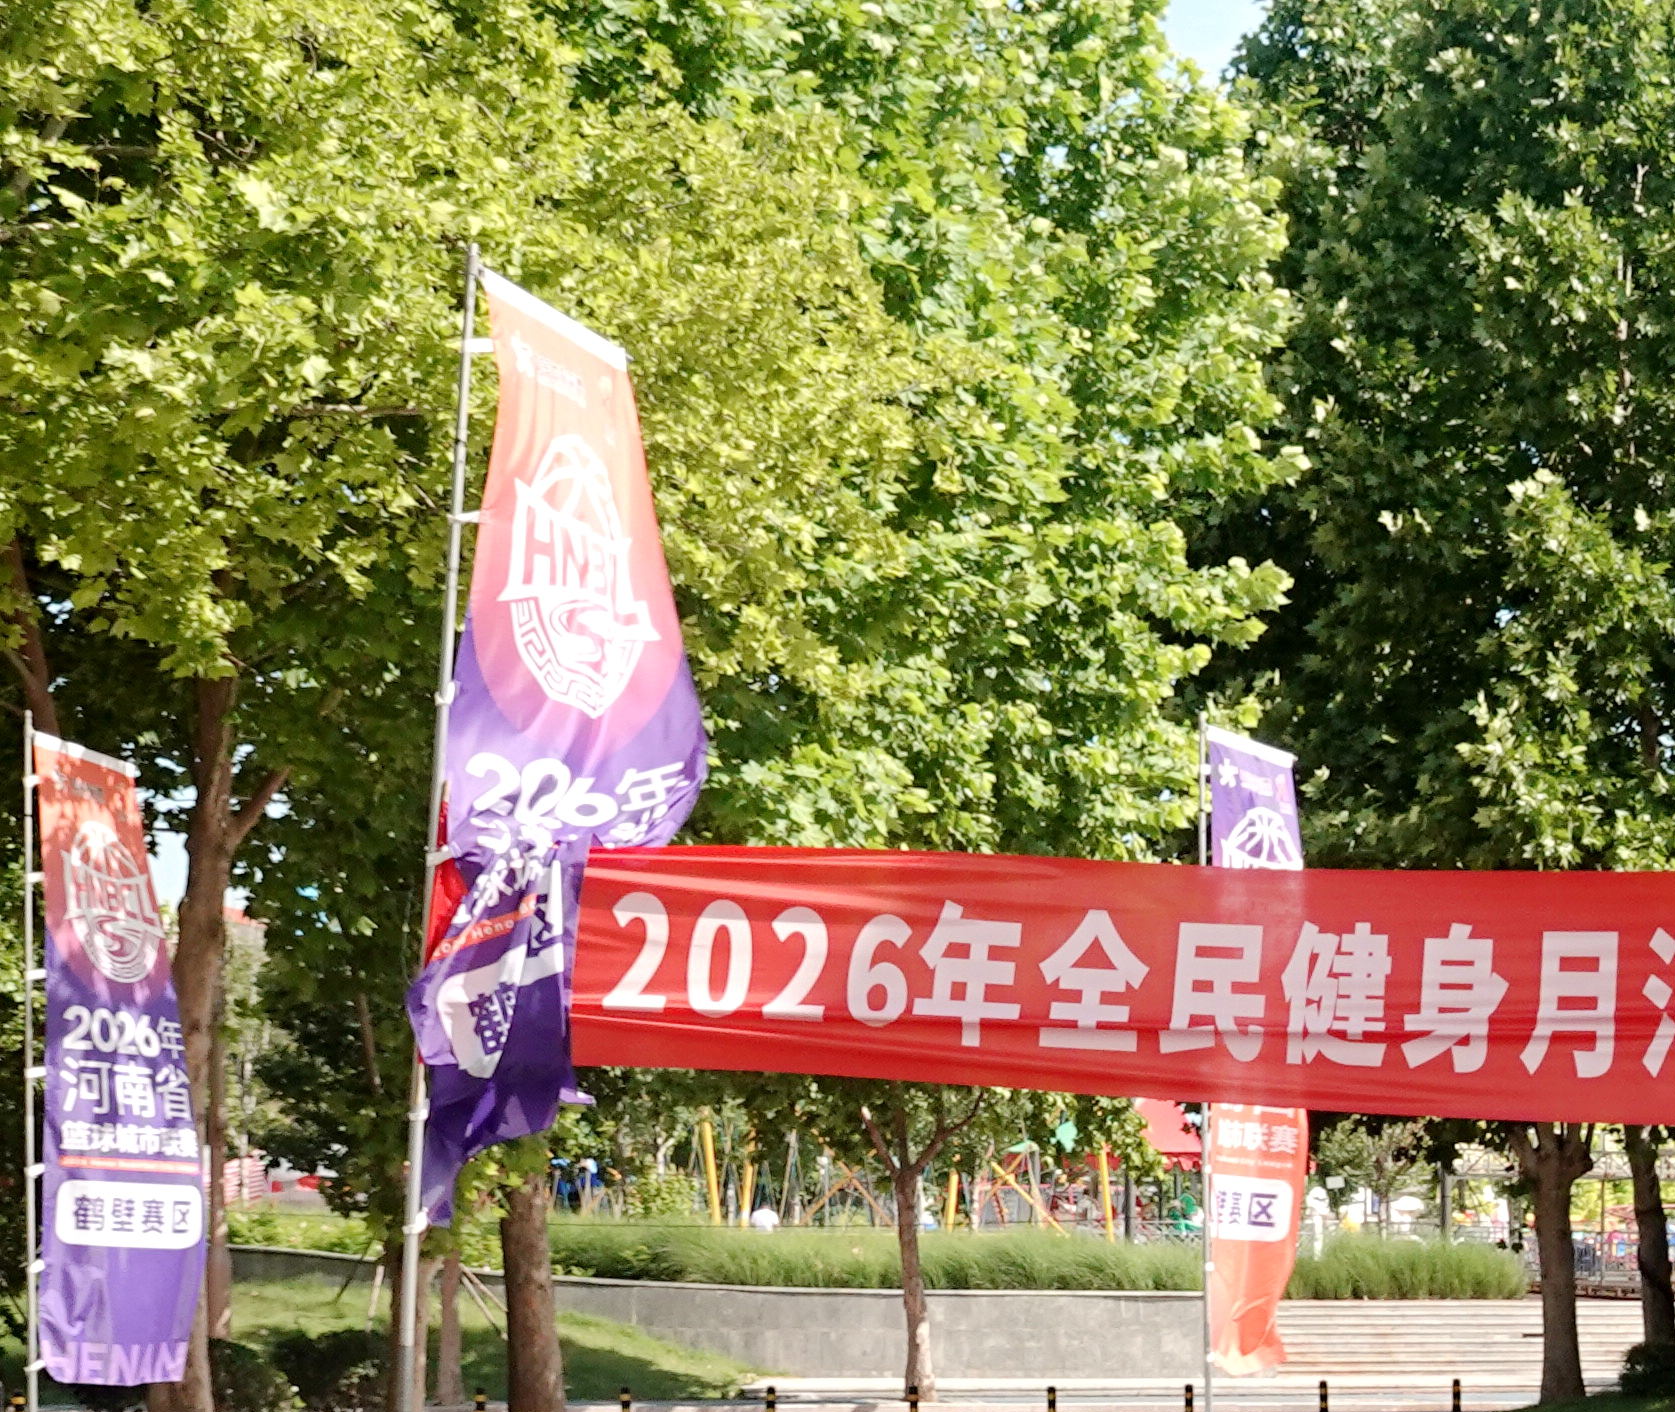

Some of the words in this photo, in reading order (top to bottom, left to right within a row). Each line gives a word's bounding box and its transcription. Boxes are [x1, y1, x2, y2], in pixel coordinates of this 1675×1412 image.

[62, 1005, 184, 1061] 2026年
[59, 1056, 192, 1122] 河南省
[73, 1193, 192, 1235] 鹤壁赛区
